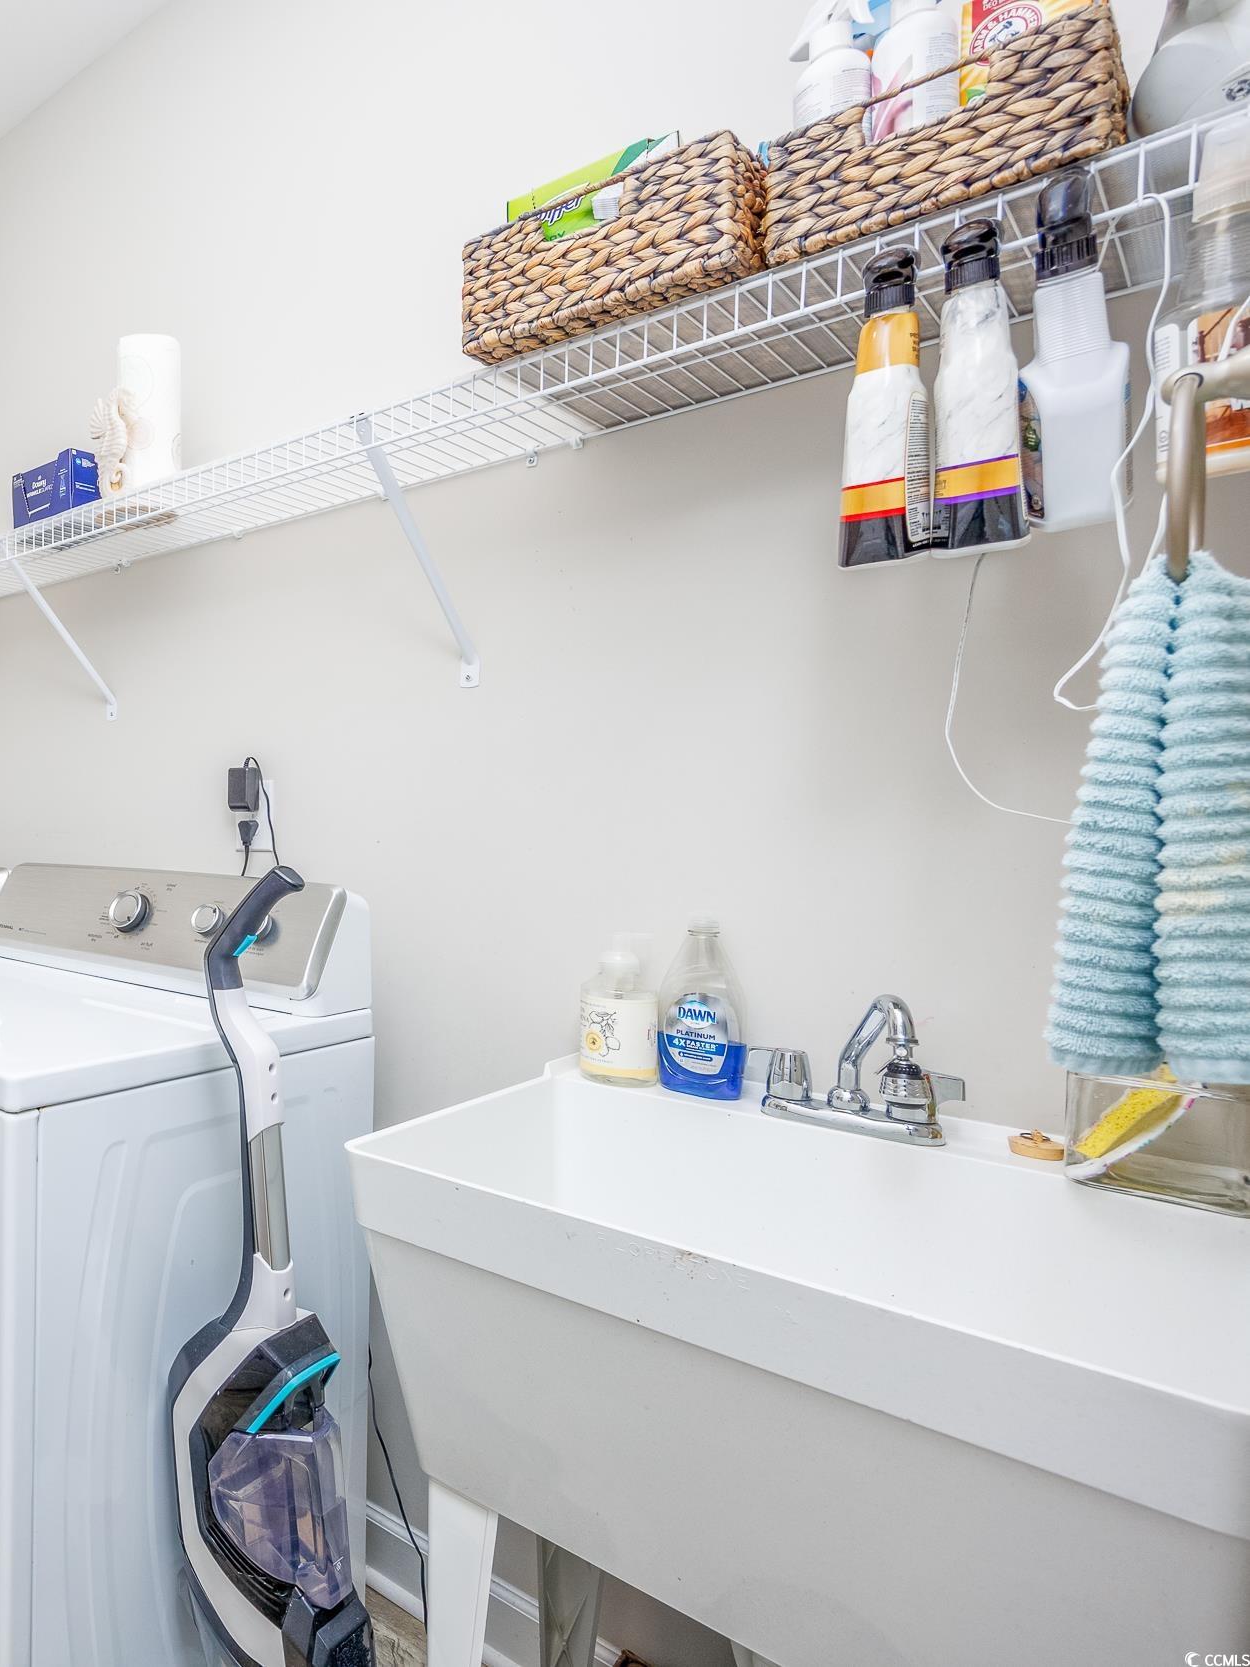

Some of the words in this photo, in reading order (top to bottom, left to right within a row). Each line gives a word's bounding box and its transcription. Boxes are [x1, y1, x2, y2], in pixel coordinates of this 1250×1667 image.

[678, 1006, 716, 1023] DAWN
[676, 1029, 716, 1040] PLATINUM
[673, 1038, 685, 1046] 4X
[686, 1040, 716, 1050] FASTER
